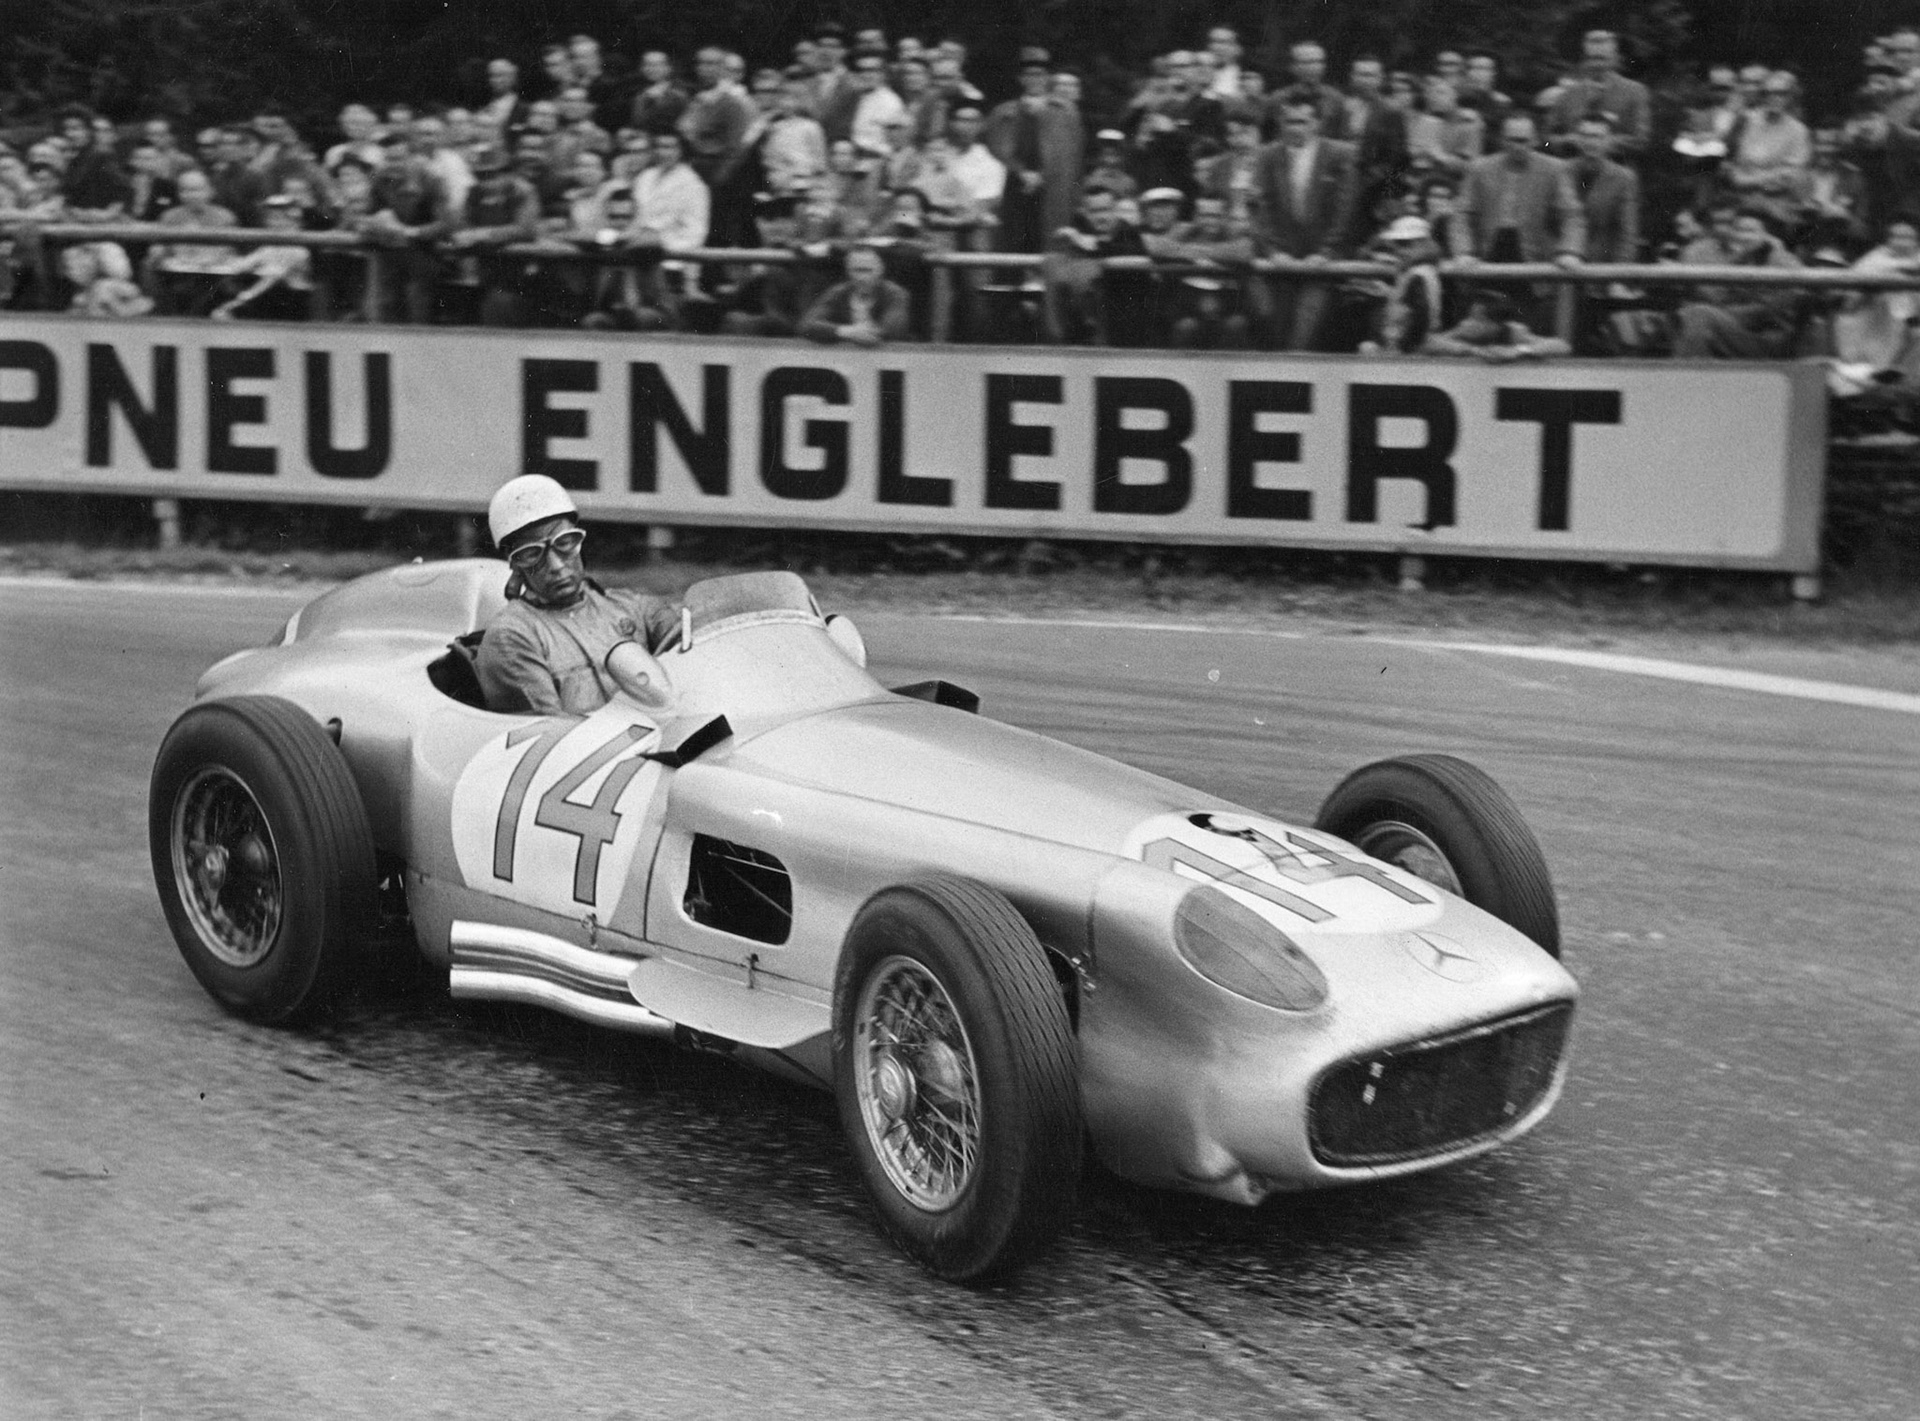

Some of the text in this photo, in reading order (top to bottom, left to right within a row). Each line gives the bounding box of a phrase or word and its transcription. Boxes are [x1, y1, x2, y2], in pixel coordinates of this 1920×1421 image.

[521, 357, 1622, 533] ENGLEBERT
[493, 717, 656, 907] 14
[1142, 826, 1434, 924] 14
